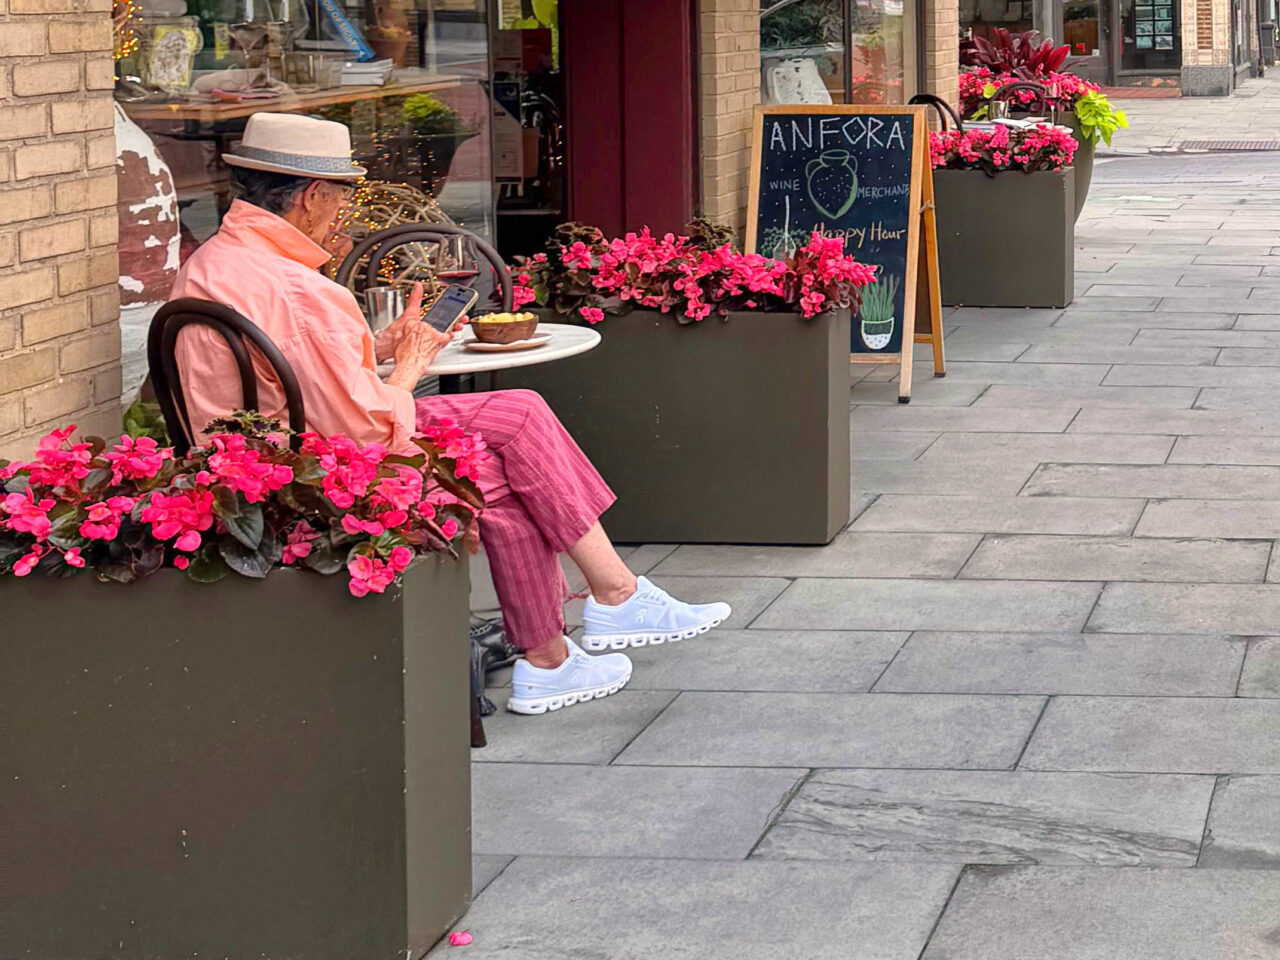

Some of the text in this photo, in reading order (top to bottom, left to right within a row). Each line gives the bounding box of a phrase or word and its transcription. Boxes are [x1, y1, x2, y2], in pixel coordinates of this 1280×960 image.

[770, 116, 905, 151] ANFORA
[769, 179, 800, 191] WINE
[871, 220, 906, 241] Hour
